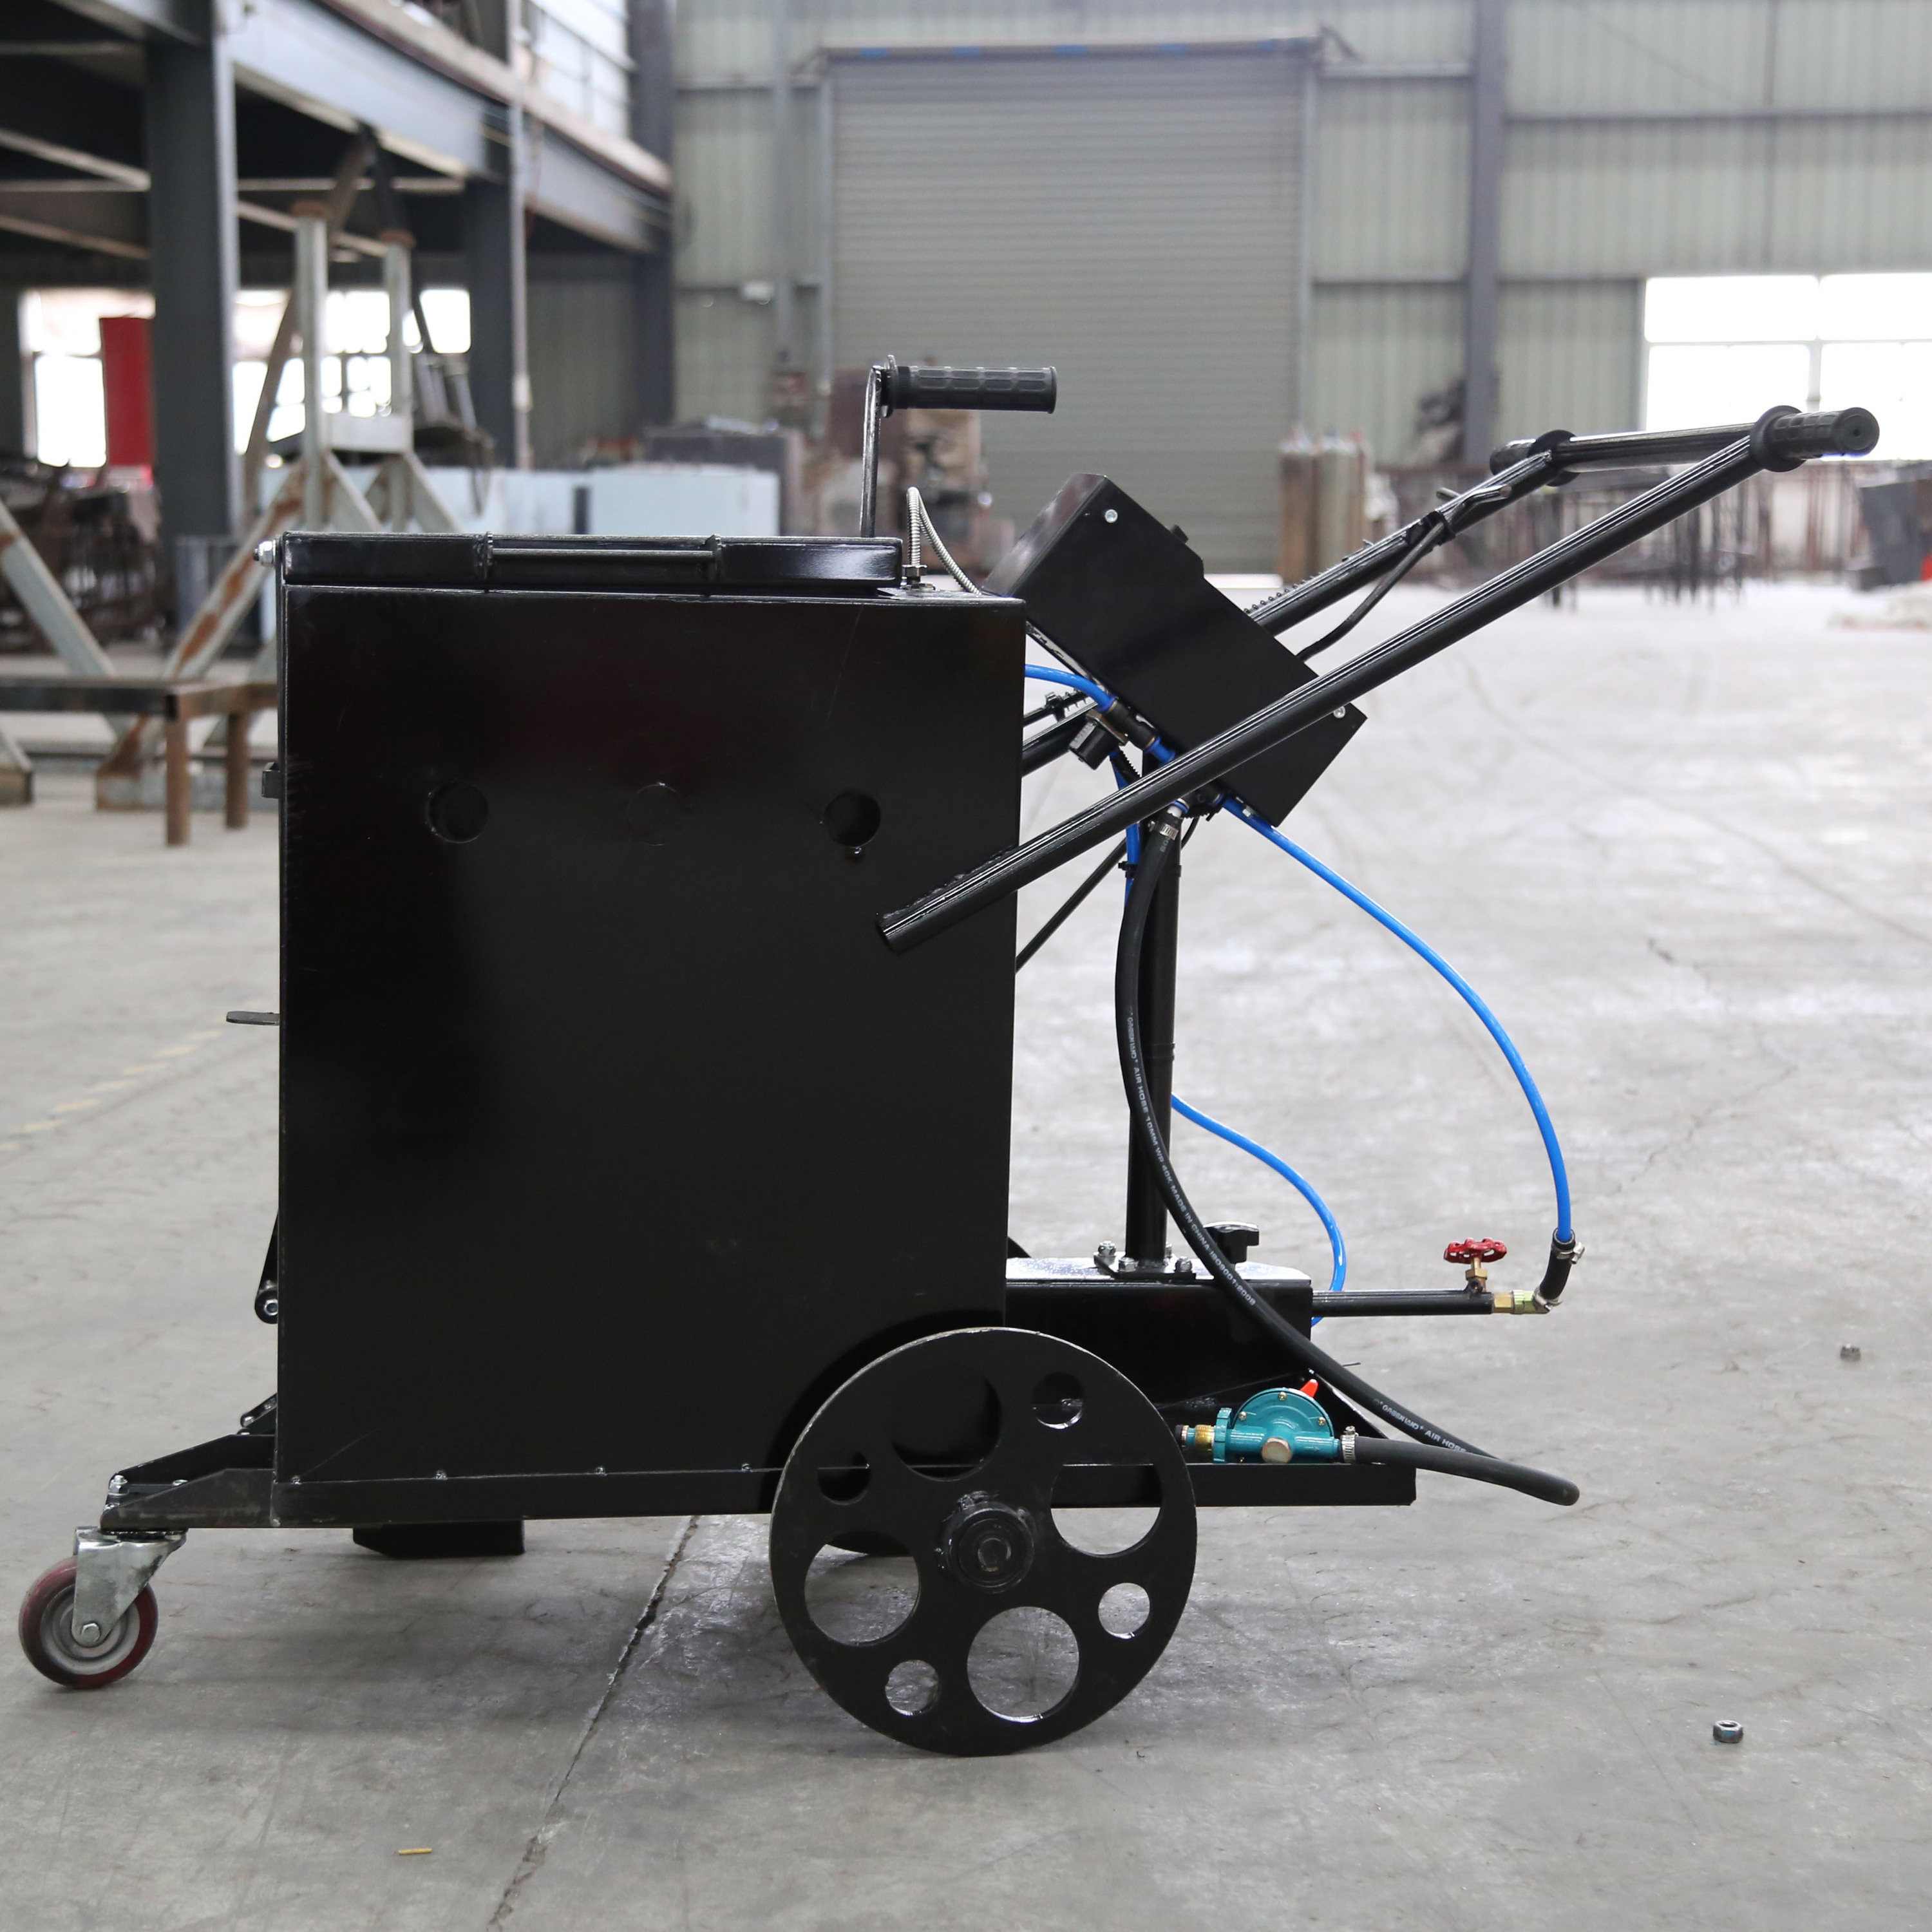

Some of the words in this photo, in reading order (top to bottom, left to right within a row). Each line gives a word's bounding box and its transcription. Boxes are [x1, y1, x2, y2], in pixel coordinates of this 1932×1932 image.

[1137, 1086, 1149, 1113] HOSE
[1146, 1116, 1159, 1146] 10MM
[1155, 1147, 1164, 1162] WP
[1171, 1185, 1187, 1212] MADE
[1185, 1213, 1193, 1223] IN
[1191, 1224, 1210, 1251] CHINA
[1425, 1430, 1441, 1442] AIR
